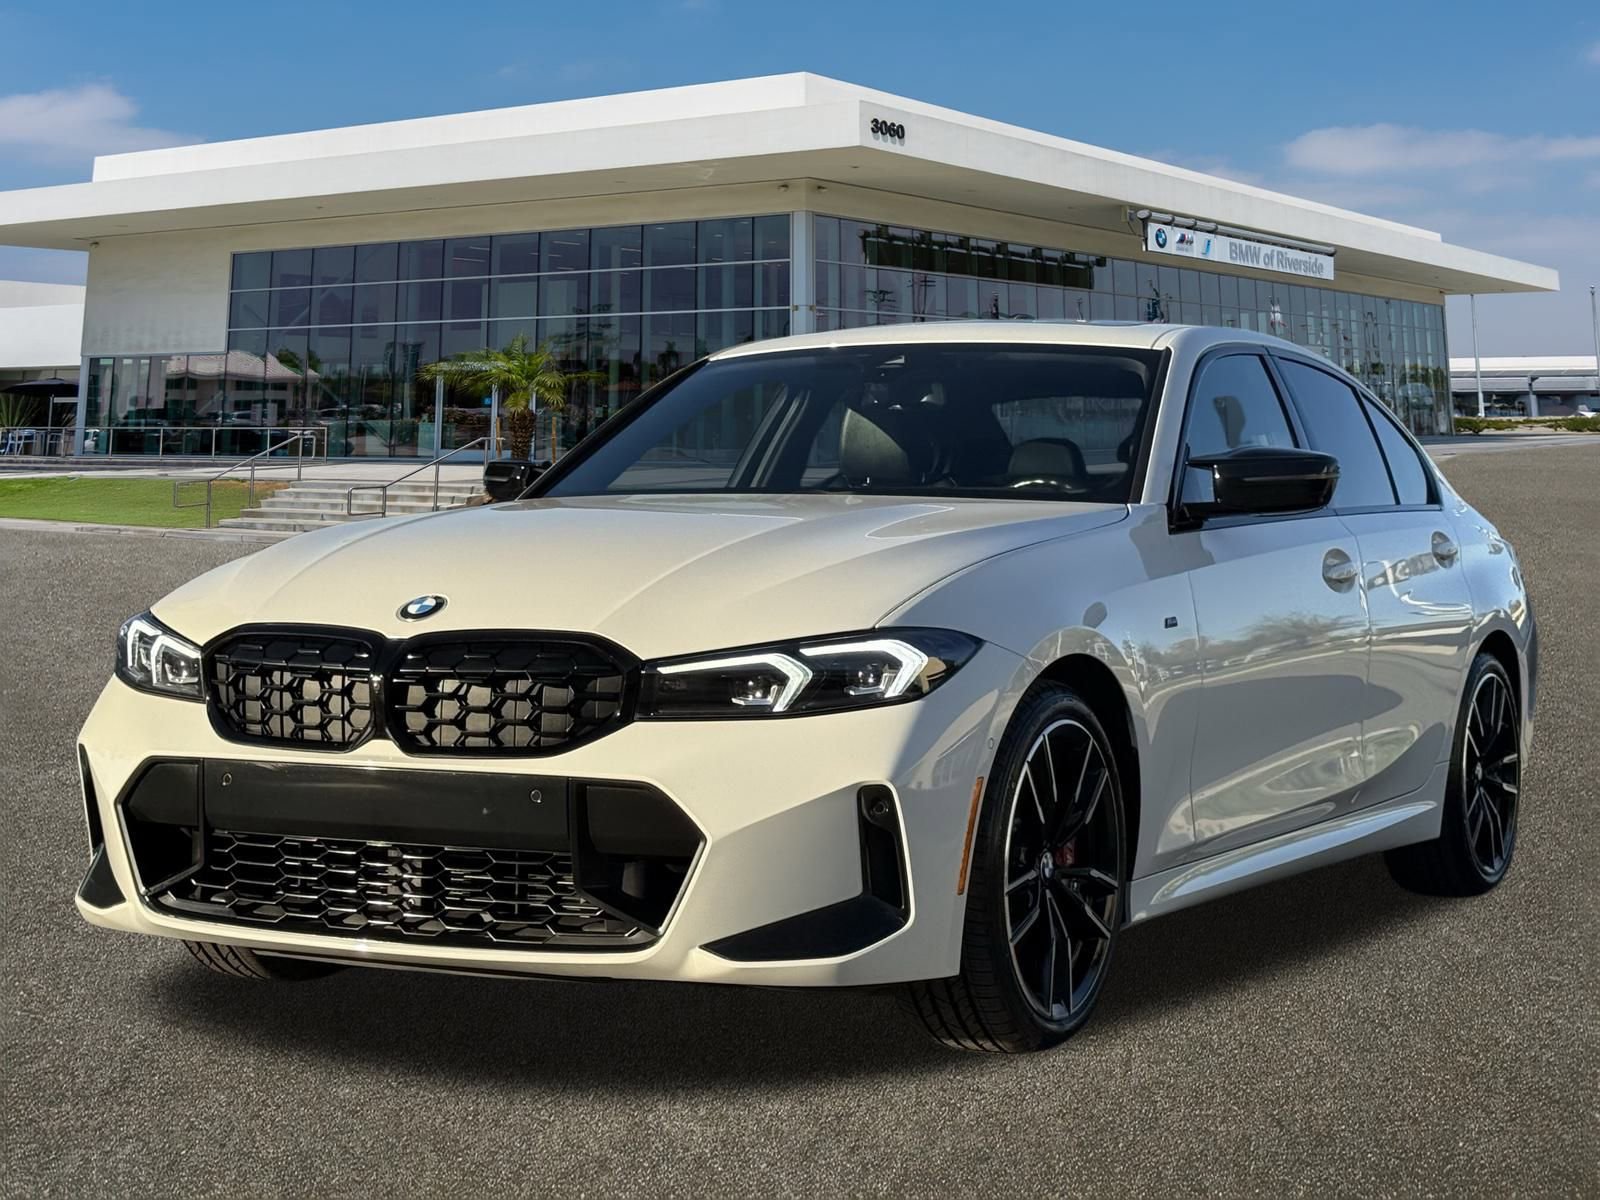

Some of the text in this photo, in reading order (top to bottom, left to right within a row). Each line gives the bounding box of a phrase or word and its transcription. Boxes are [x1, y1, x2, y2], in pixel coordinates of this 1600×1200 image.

[870, 118, 905, 140] 3060
[1229, 241, 1324, 275] BMW of Riverside
